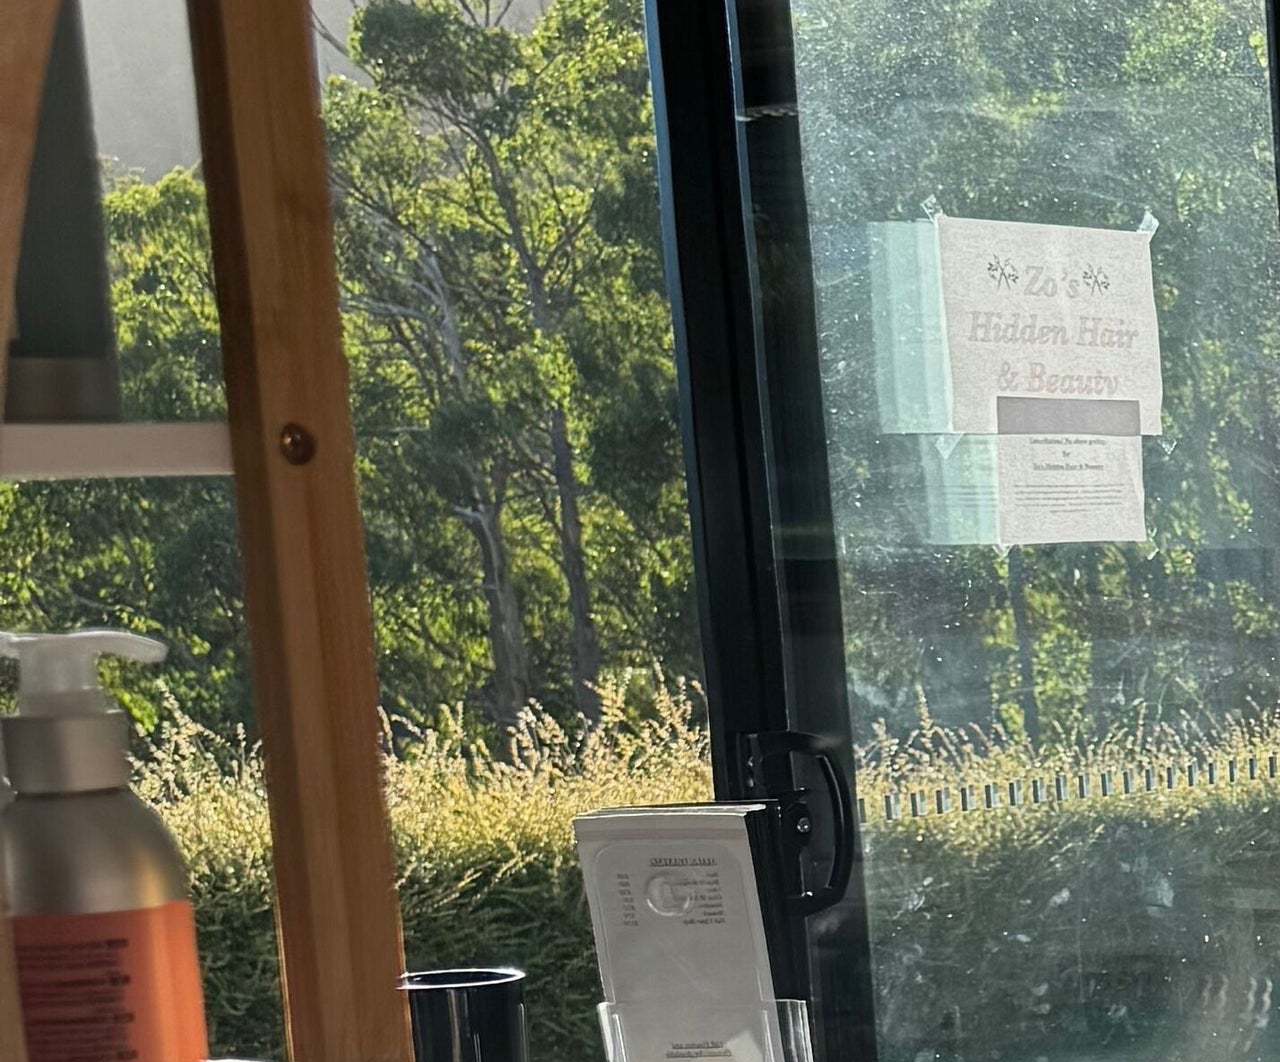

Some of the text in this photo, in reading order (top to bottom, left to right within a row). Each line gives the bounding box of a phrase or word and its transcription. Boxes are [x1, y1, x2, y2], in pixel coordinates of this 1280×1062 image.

[1023, 265, 1081, 299] Zo's
[967, 310, 1140, 350] Hidden Hair
[997, 361, 1120, 396] & Beauty
